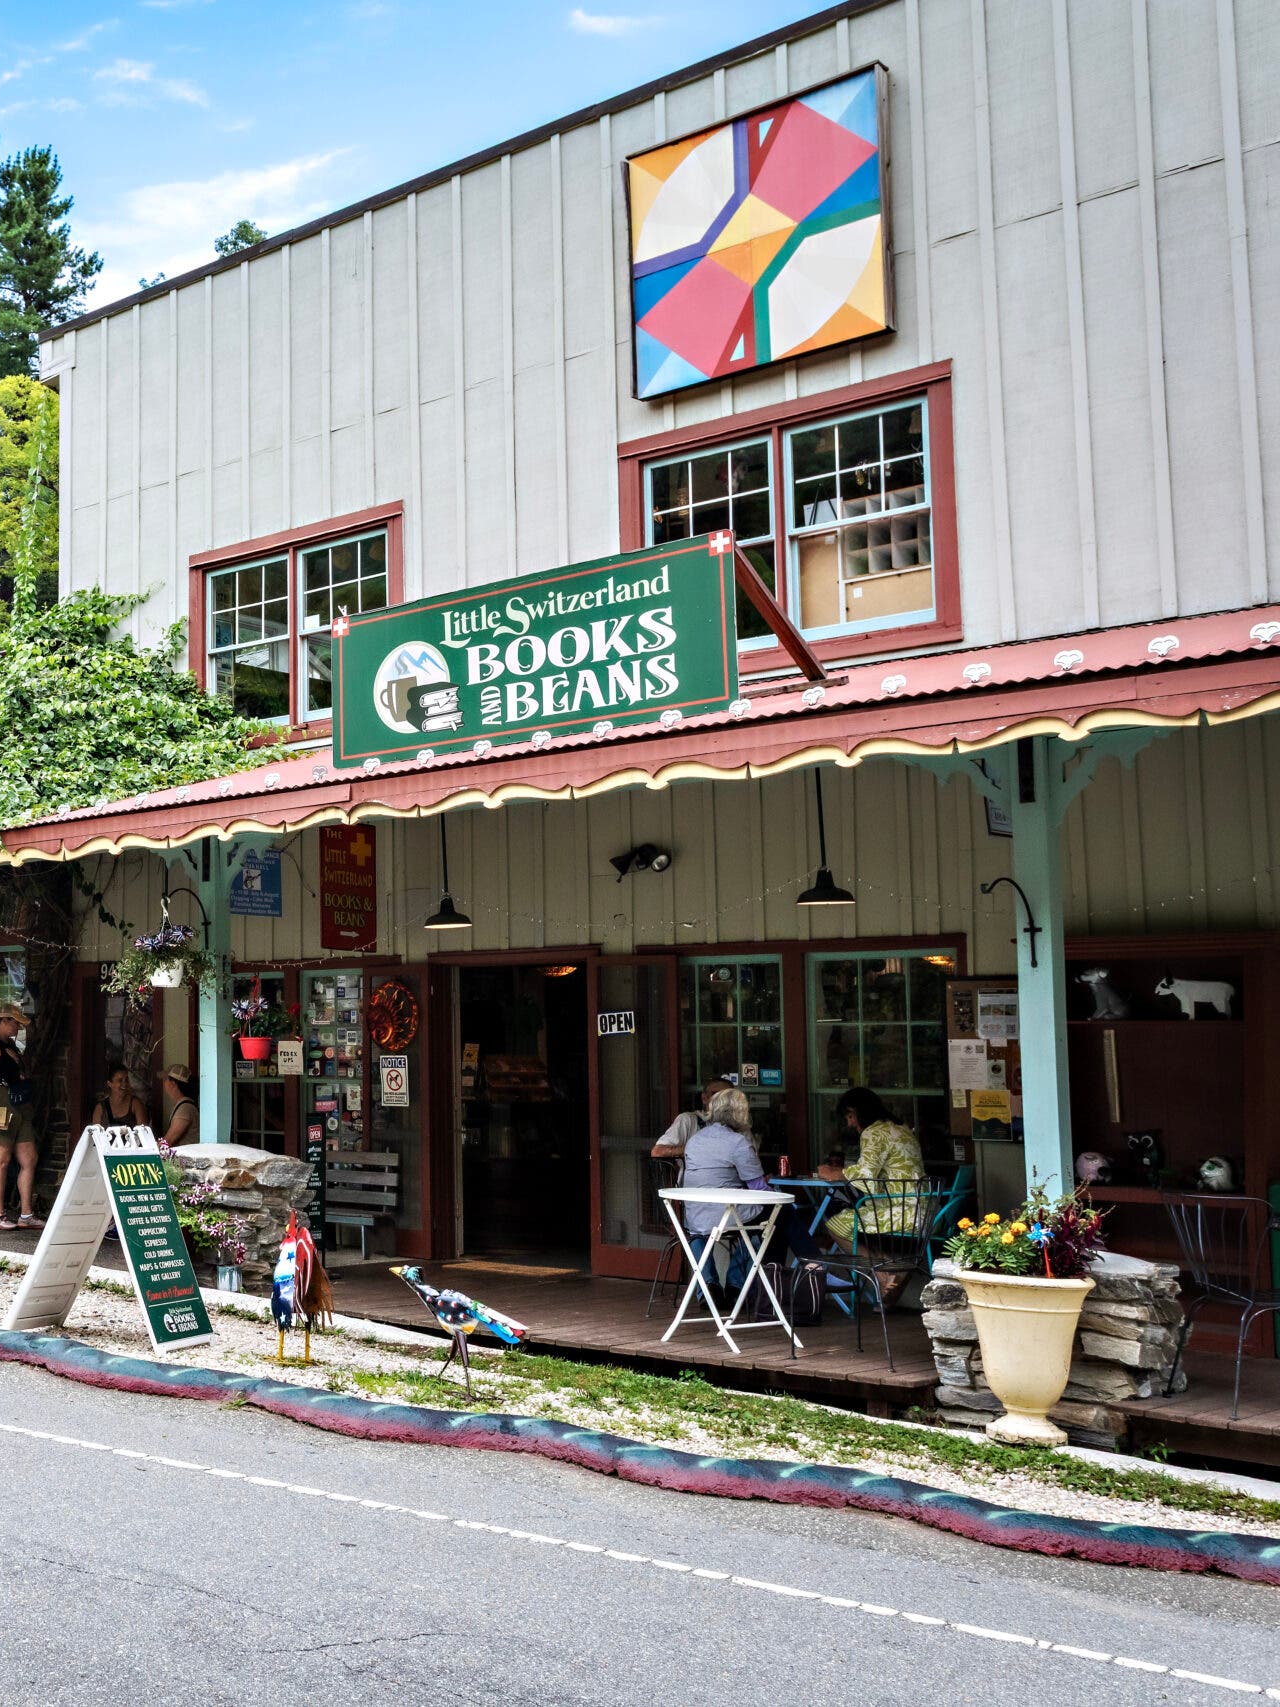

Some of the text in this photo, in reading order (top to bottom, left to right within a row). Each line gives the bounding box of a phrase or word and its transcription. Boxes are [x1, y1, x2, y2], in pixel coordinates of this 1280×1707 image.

[440, 566, 670, 648] Little Switzerland
[467, 606, 677, 686] BOOKS
[505, 653, 679, 723] BEANS
[480, 685, 502, 726] AND
[325, 828, 343, 840] THE
[324, 849, 347, 864] LITTLE
[323, 866, 373, 887] SWITZERLAND
[324, 893, 373, 912] BOOKS &
[334, 911, 365, 928] BEANS
[600, 1013, 633, 1034] OPEN
[383, 1058, 406, 1068] NOTICE
[116, 1163, 160, 1187] OPEN
[137, 1194, 148, 1202] NEW
[154, 1193, 167, 1201] USED
[151, 1204, 164, 1212] GIFTS
[127, 1217, 145, 1226] COFFEE
[144, 1238, 168, 1248] ESPRESSO
[144, 1248, 174, 1259] COLD DRINKS
[139, 1263, 153, 1272] MAPS
[159, 1259, 186, 1269] COMPASSES
[151, 1271, 181, 1282] ART GALLERY
[174, 1312, 196, 1324] BOOKS
